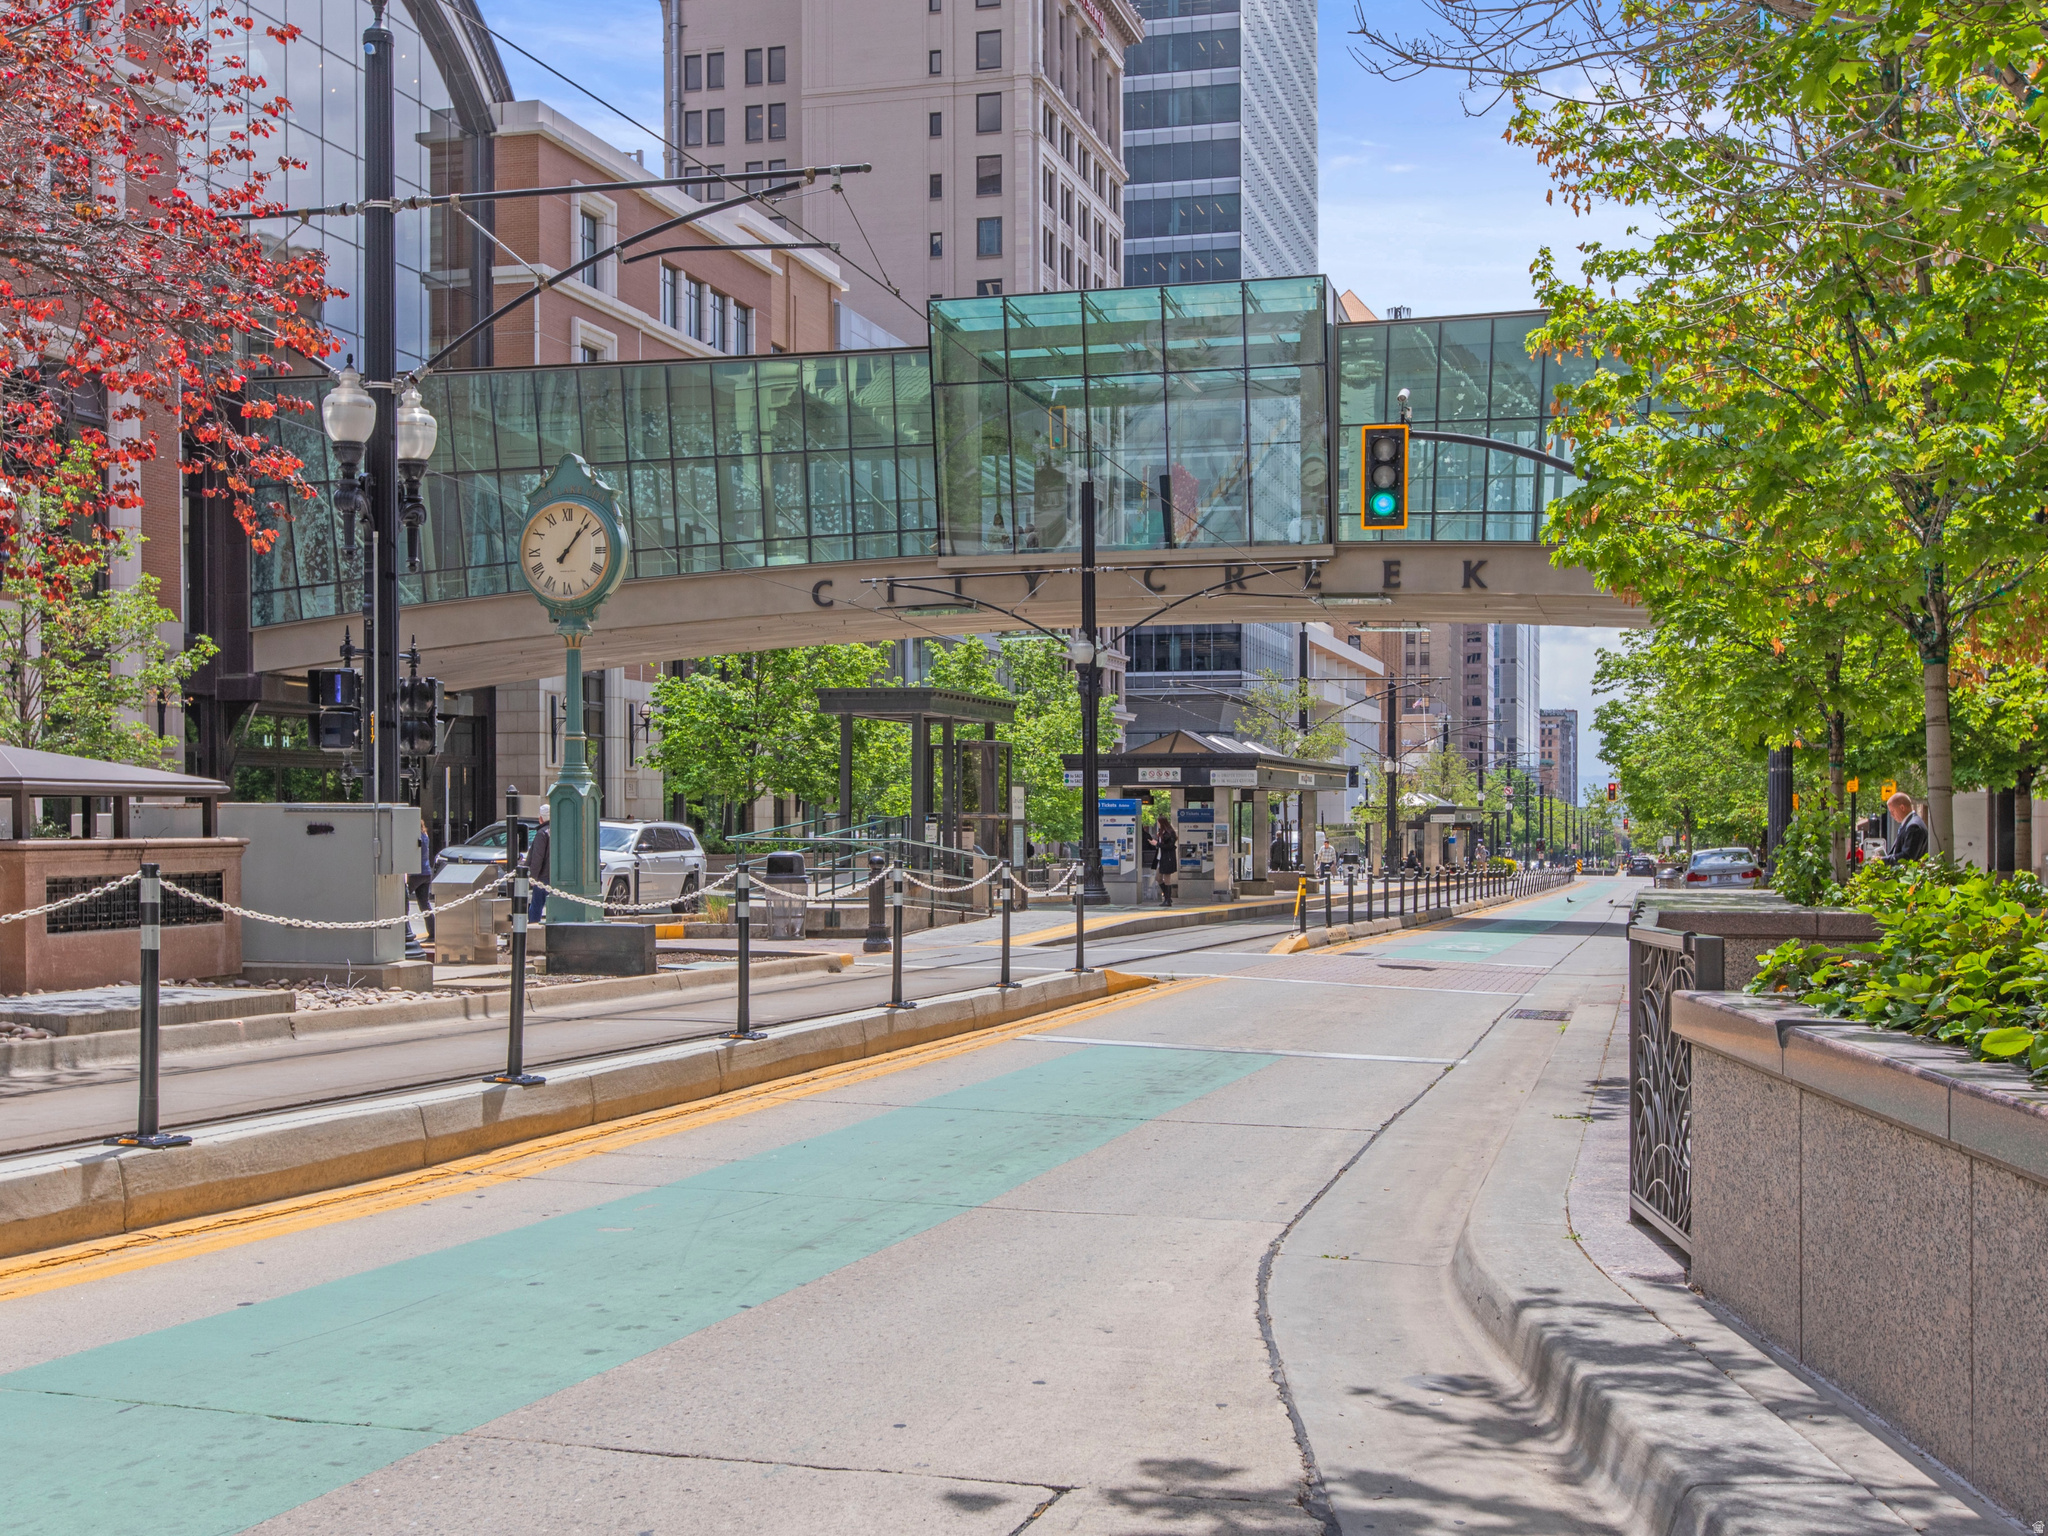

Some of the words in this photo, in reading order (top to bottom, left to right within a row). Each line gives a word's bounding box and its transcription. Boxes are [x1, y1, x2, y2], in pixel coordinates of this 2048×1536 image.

[557, 485, 583, 495] LAKE
[585, 487, 606, 504] CITY
[811, 569, 1044, 608] CITY
[1143, 558, 1488, 593] CREEK
